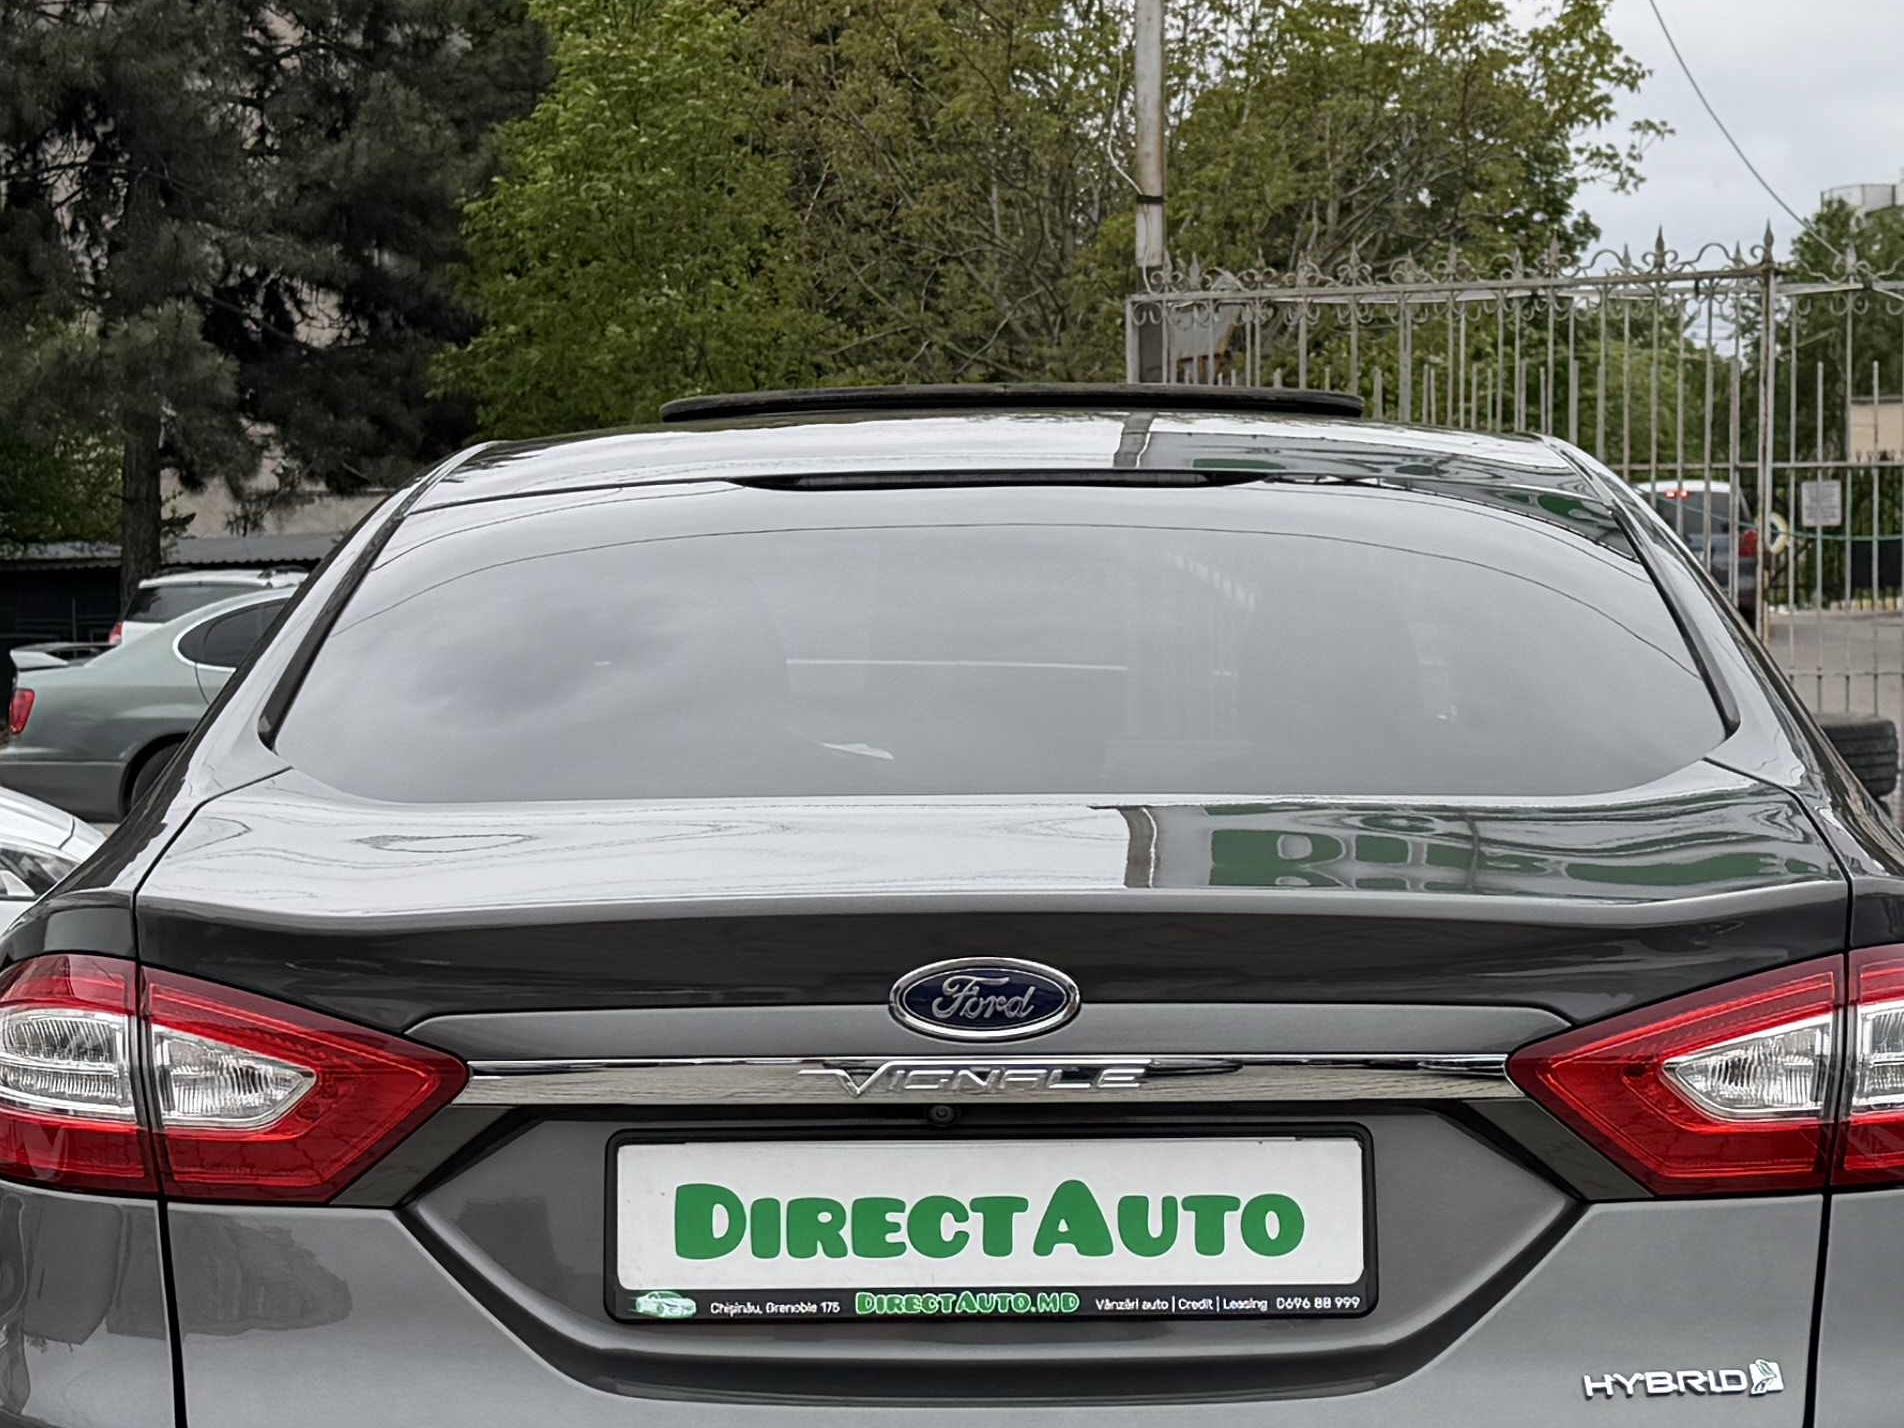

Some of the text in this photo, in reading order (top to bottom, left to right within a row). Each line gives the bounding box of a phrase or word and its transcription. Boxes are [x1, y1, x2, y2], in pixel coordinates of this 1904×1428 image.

[931, 974, 1036, 1019] Ford
[797, 1059, 1152, 1098] VIGNALE
[673, 1180, 1306, 1260] DIRECTAUTO
[854, 1290, 1081, 1316] DIRECTAUTO.MD
[1141, 1298, 1169, 1311] auto
[1276, 1297, 1311, 1310] 0696
[1314, 1297, 1332, 1309] 88
[1335, 1297, 1361, 1309] 999
[1583, 1368, 1749, 1399] HYBRID
